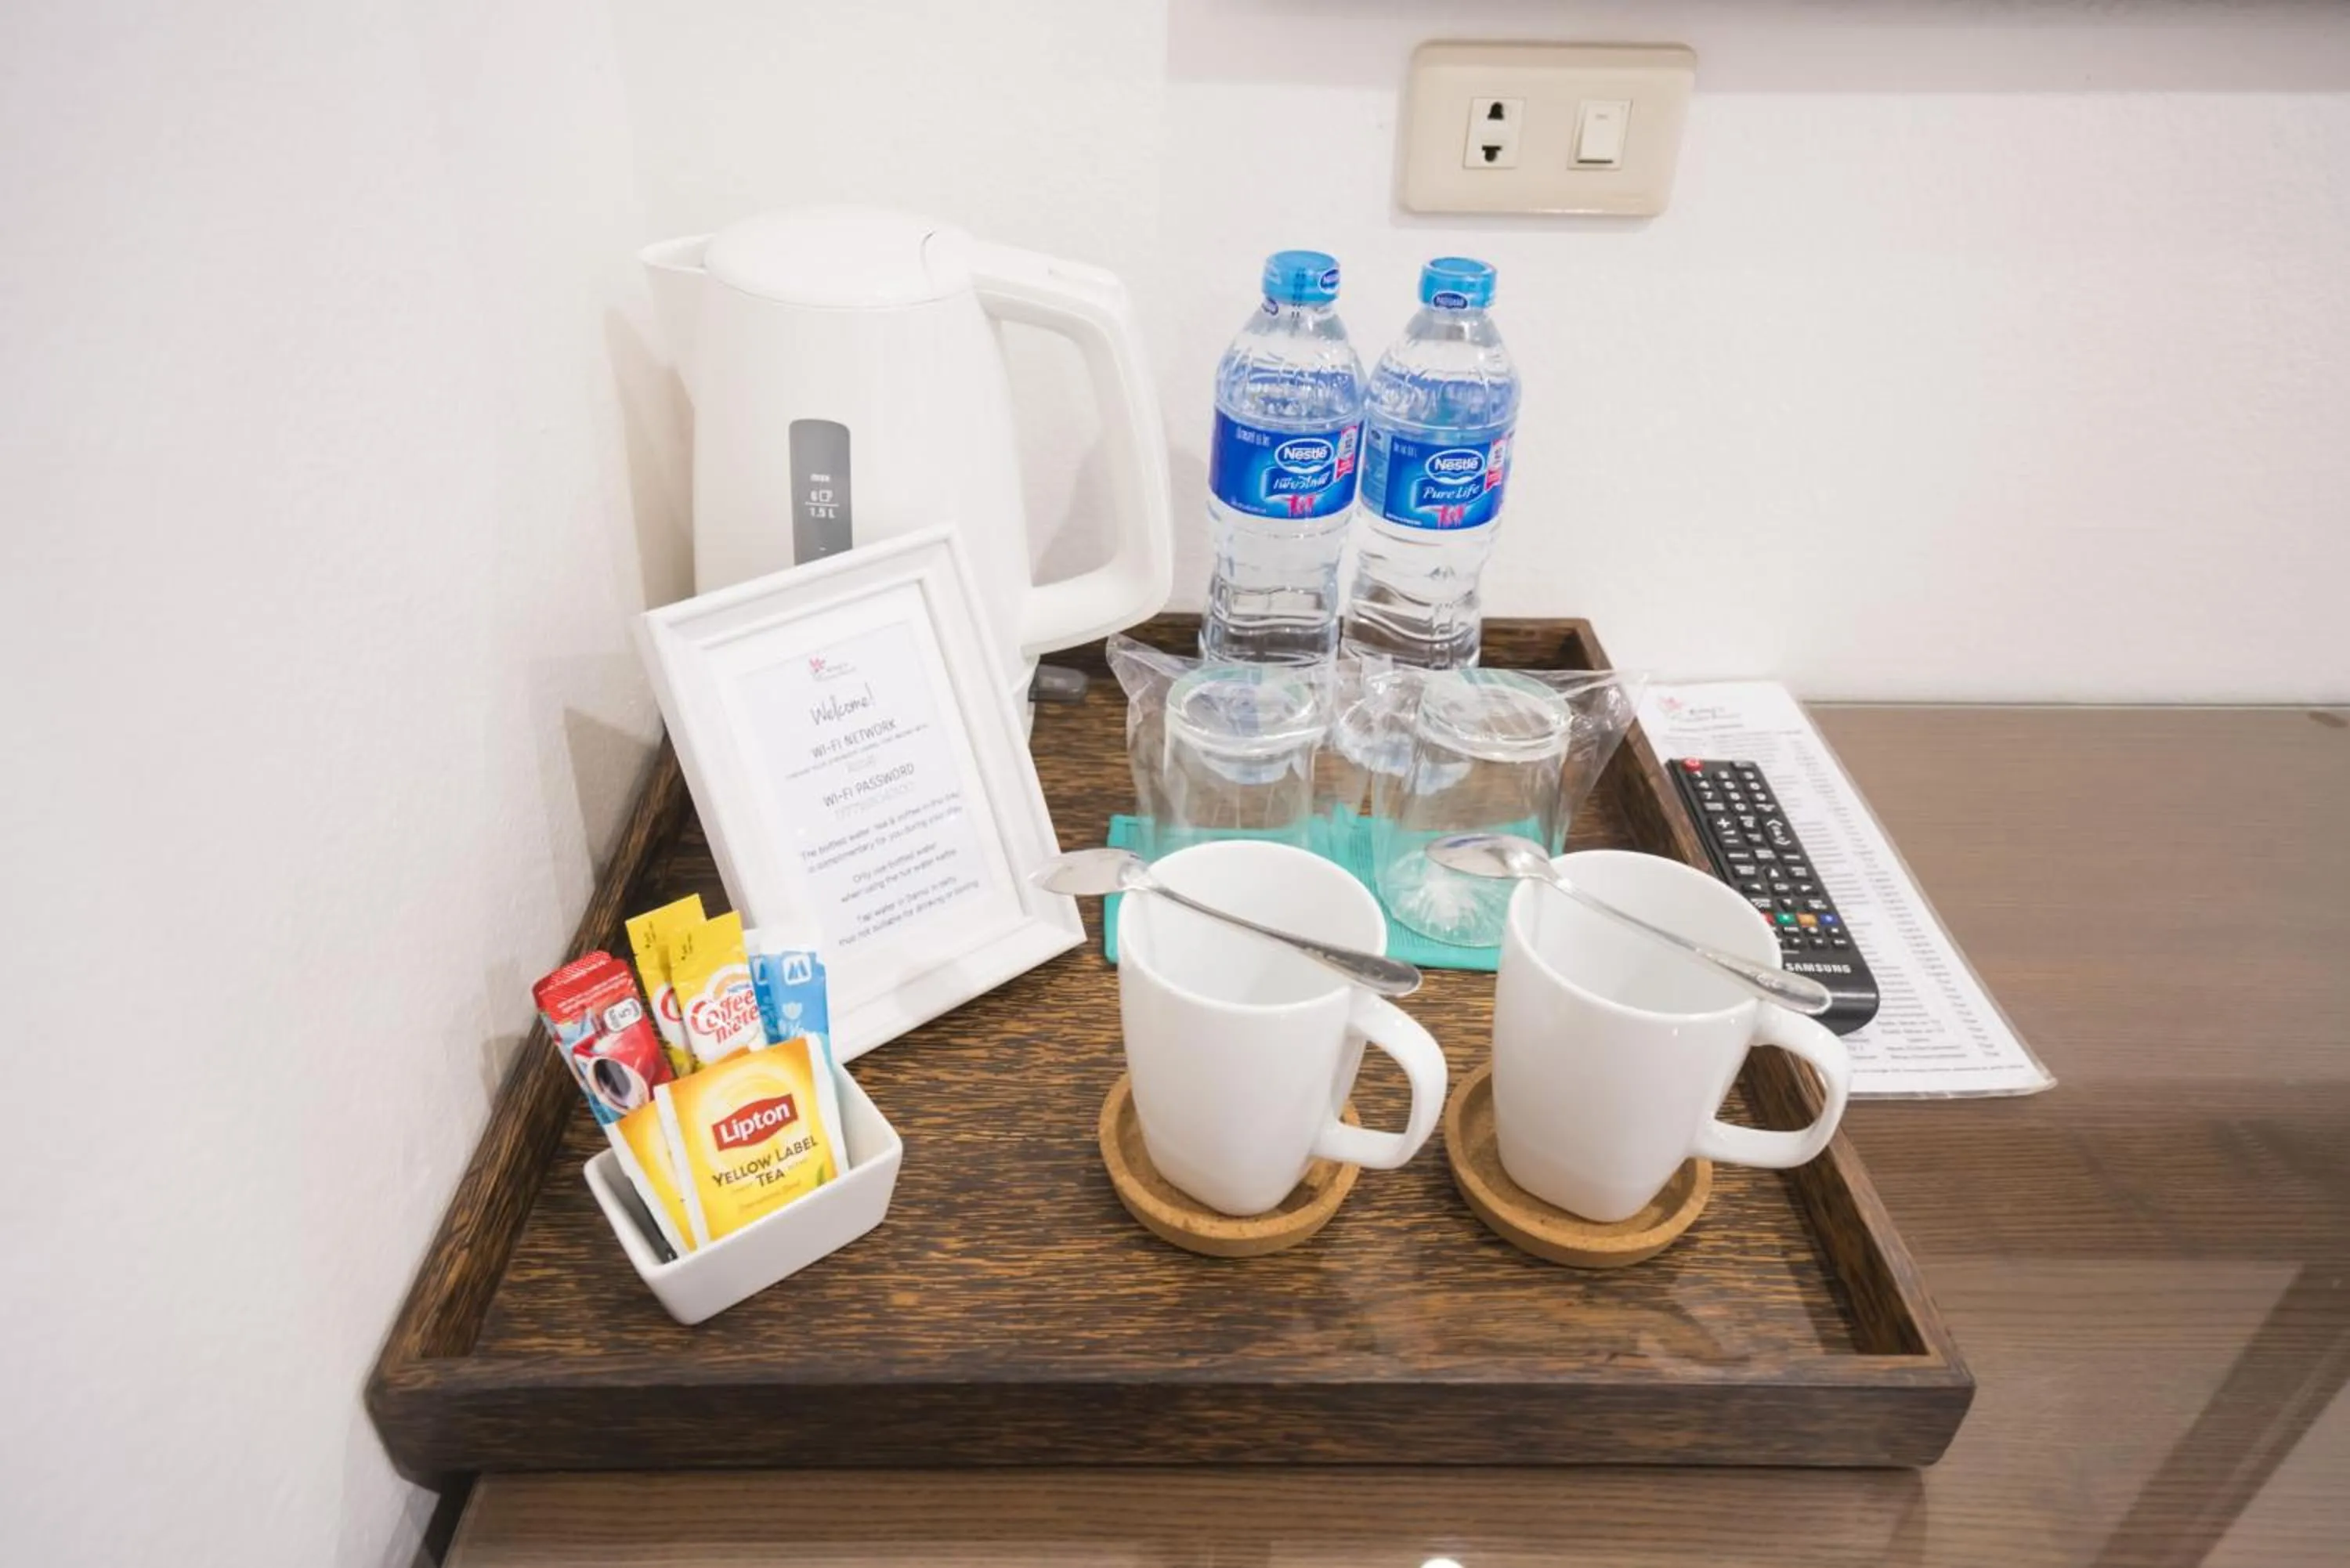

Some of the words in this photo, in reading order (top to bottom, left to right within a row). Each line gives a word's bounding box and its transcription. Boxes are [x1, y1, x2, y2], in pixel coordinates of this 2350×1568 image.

[1284, 446, 1328, 461] Nestlé
[1434, 457, 1479, 471] Nestlé
[1423, 486, 1455, 499] Pure
[1455, 483, 1480, 499] Life
[810, 683, 876, 726] Welcome!
[812, 739, 842, 758] WI-FI
[844, 718, 897, 746] NETWORK
[822, 786, 854, 807] WI-FI
[855, 762, 915, 795] PASSWORD
[1785, 962, 1853, 974] SAMSUNG
[718, 1102, 791, 1144] Lipton
[711, 1154, 772, 1188] YELLOW
[775, 1135, 819, 1162] LABEL
[756, 1168, 786, 1188] TEA
